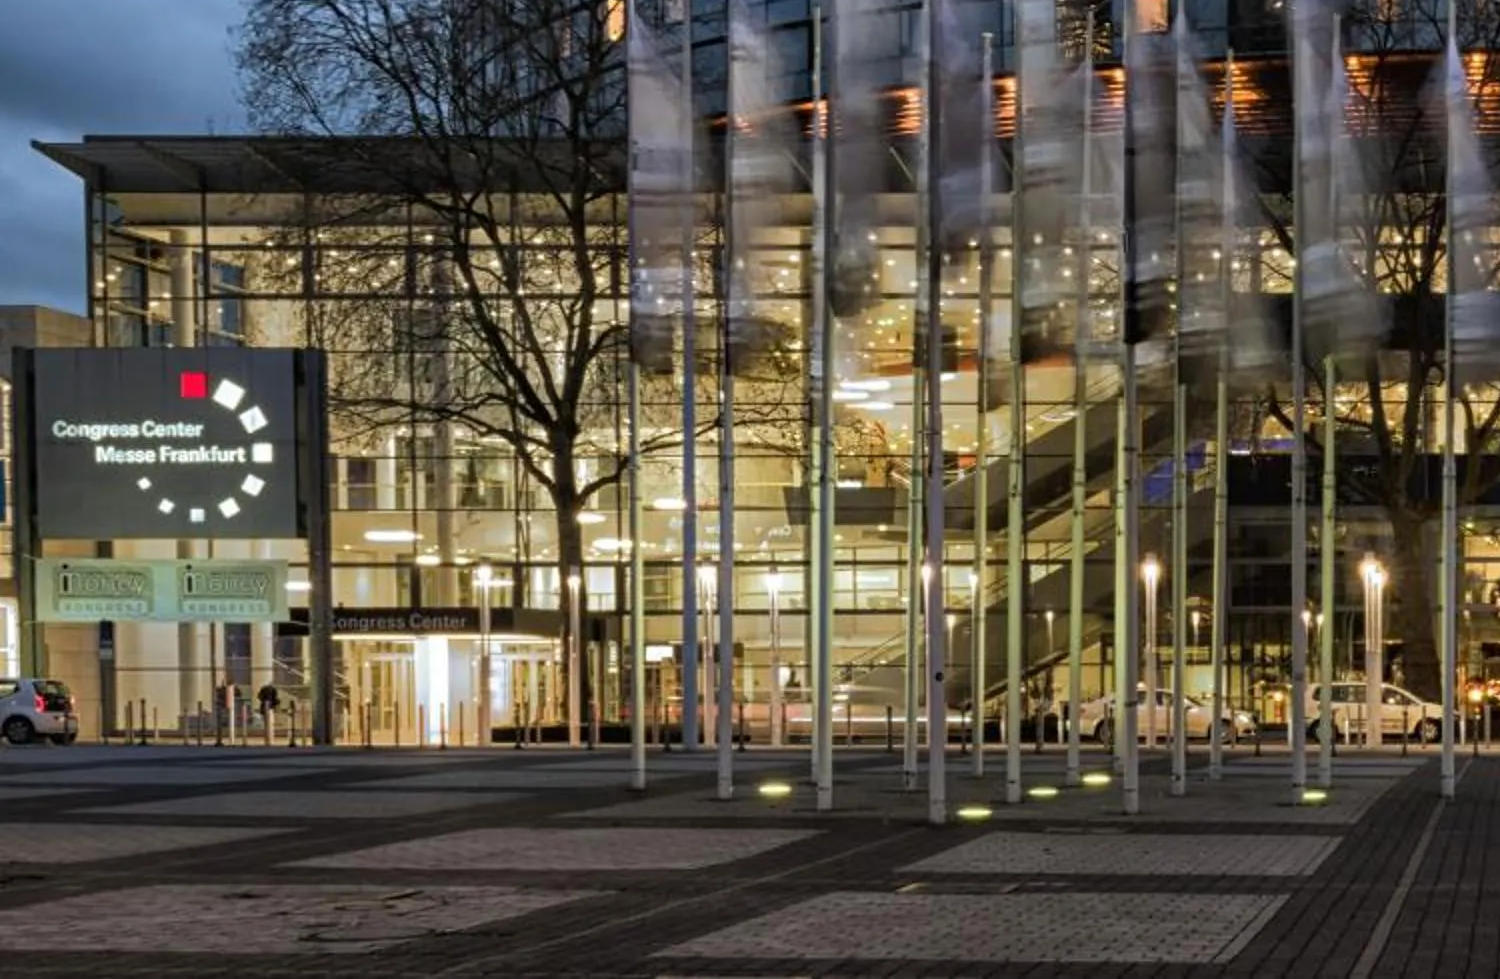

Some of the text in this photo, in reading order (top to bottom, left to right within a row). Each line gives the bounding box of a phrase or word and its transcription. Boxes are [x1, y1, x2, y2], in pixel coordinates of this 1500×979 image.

[52, 420, 204, 441] Congress Center
[95, 445, 247, 463] Messe Frankfurt
[331, 612, 466, 632] ongress Center
